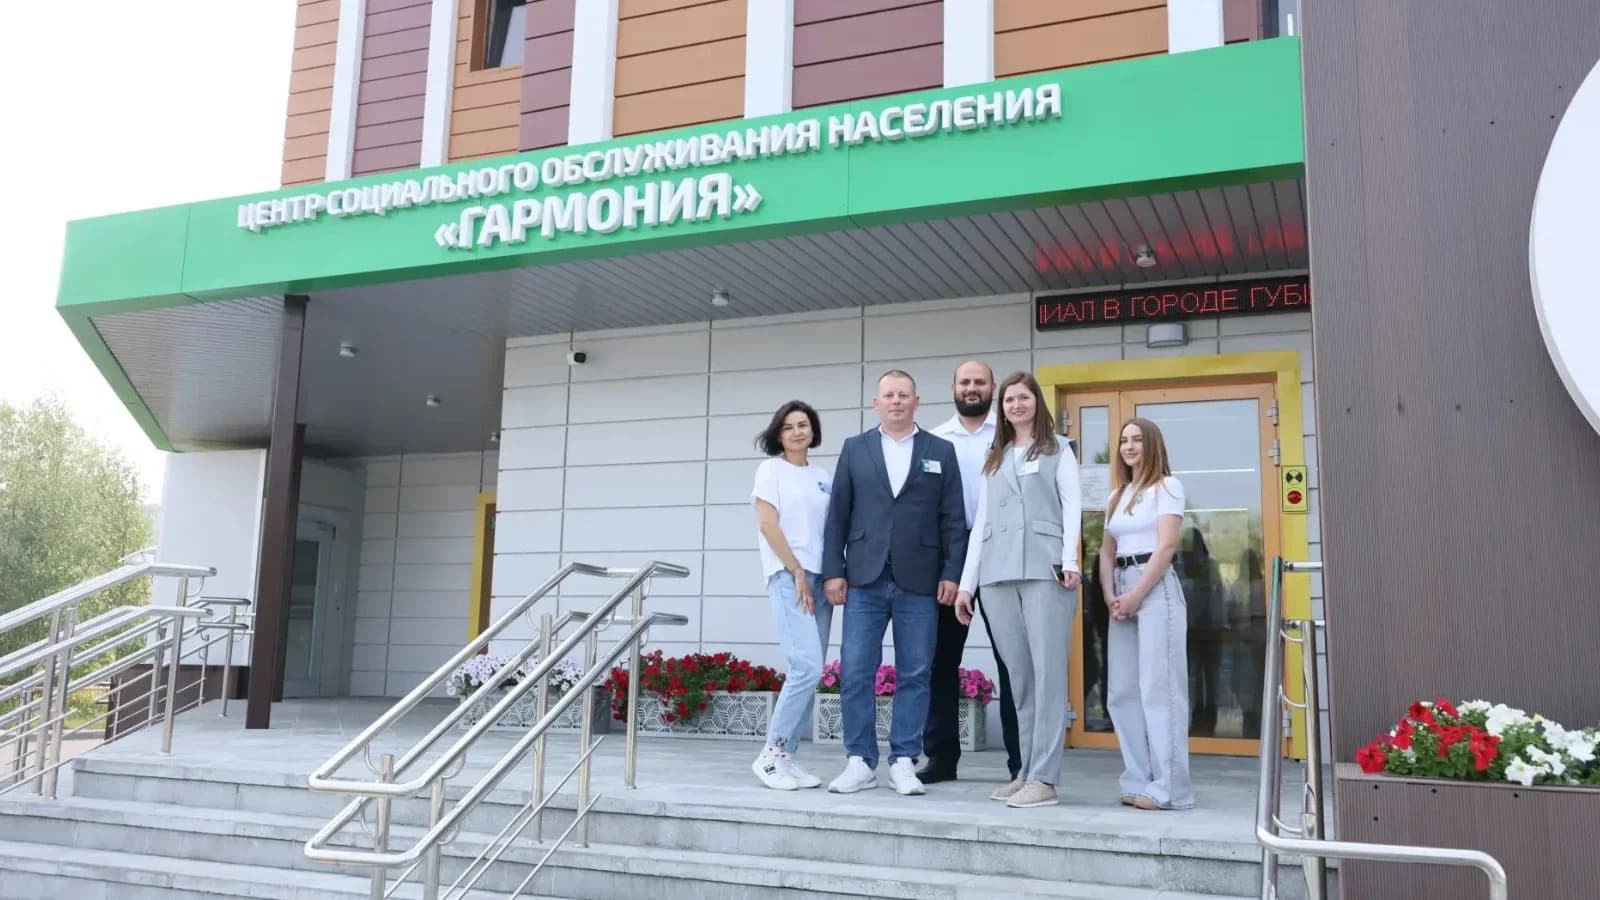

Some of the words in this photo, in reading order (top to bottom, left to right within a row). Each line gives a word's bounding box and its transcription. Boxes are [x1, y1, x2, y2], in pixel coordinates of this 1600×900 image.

[237, 195, 325, 232] ЦЕНТР
[325, 162, 538, 217] СОЦИАЛЬНОГО
[542, 118, 820, 187] ОБСЛУЖИВАНИЯ
[828, 83, 1062, 148] НАСЕЛЕНИЯ
[434, 172, 763, 250] «ГАРМОНИЯ»
[1039, 301, 1095, 324] ИАЛ
[1104, 299, 1120, 319] В
[1130, 289, 1239, 316] ГОРОДЕ
